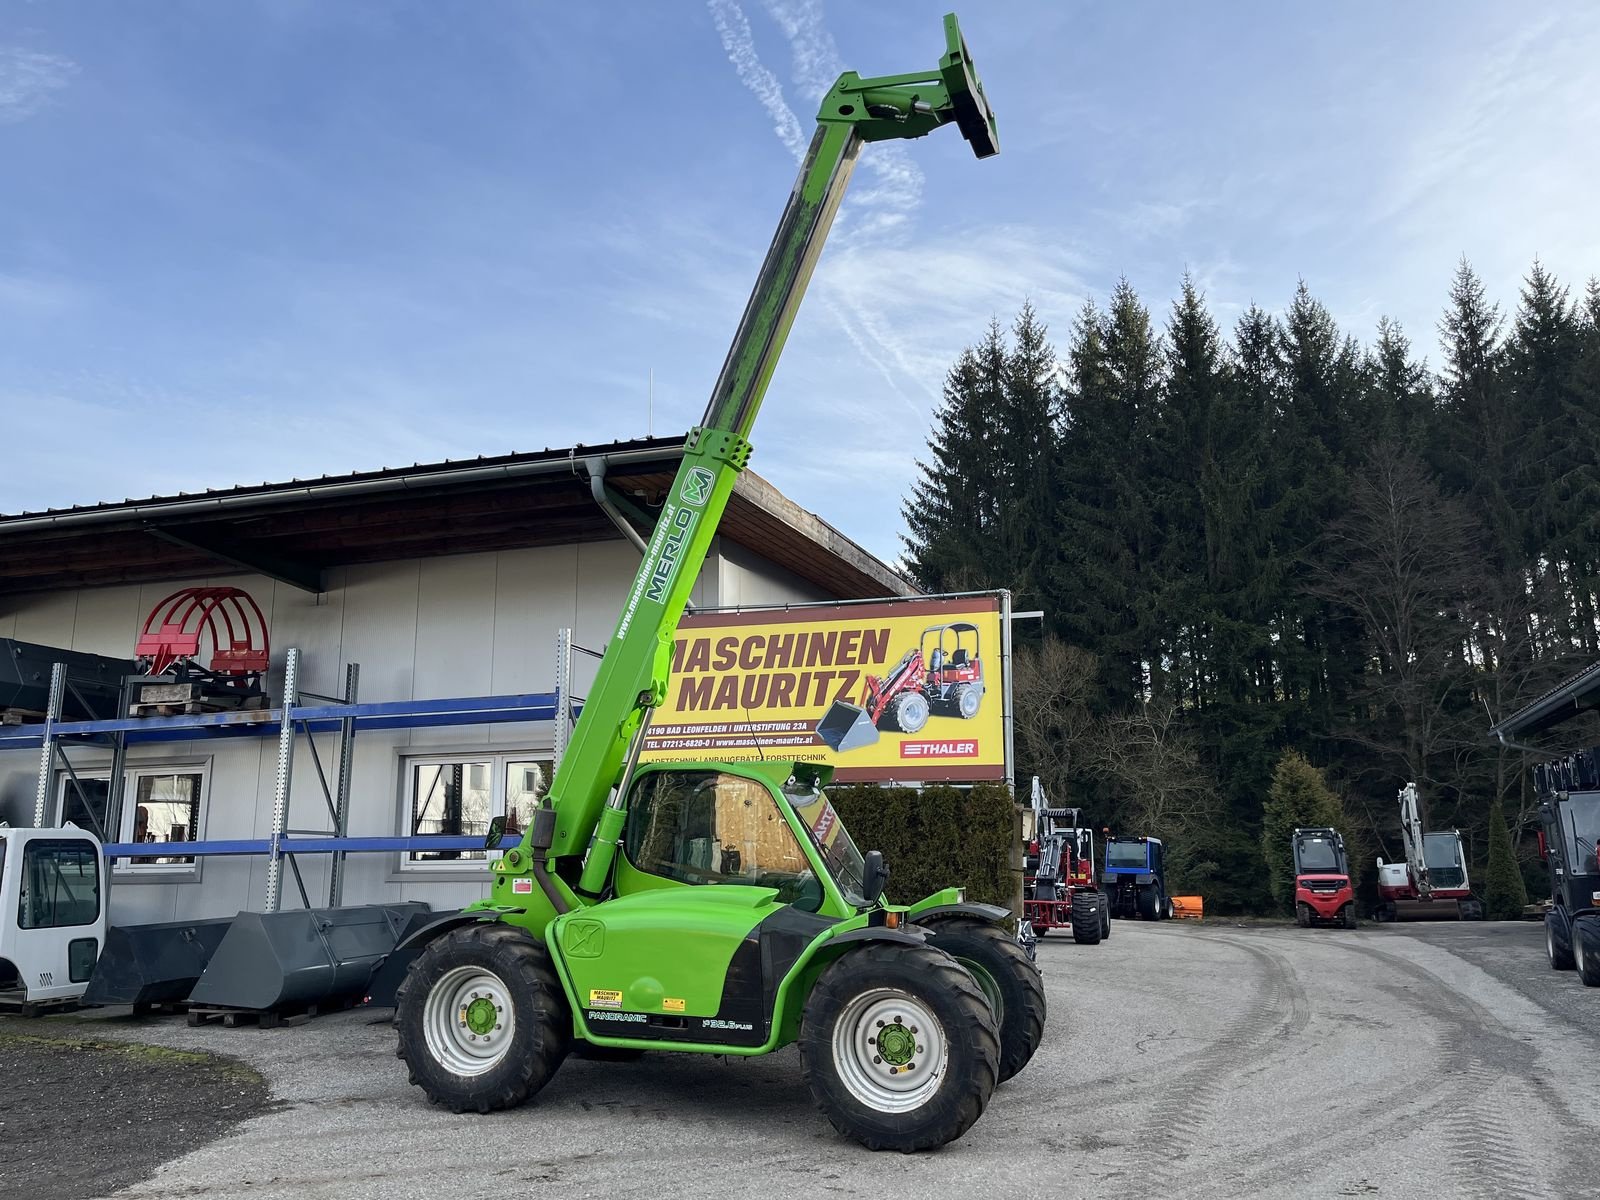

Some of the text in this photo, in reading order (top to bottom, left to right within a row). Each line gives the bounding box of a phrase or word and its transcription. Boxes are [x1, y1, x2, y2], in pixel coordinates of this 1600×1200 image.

[646, 507, 693, 603] MERLO
[616, 503, 676, 640] www.maschinen-mauritz.at
[675, 669, 861, 712] MAURITZ
[647, 722, 807, 735] 4190 BAD LEONFELDEN UNTERSTIFTUNG 23A
[647, 741, 660, 749] TEL.
[662, 739, 710, 748] 07213-6820-0
[920, 743, 974, 754] THALER
[766, 754, 826, 762] FORSTTECHNIK
[588, 1011, 647, 1023] PANORAMIC
